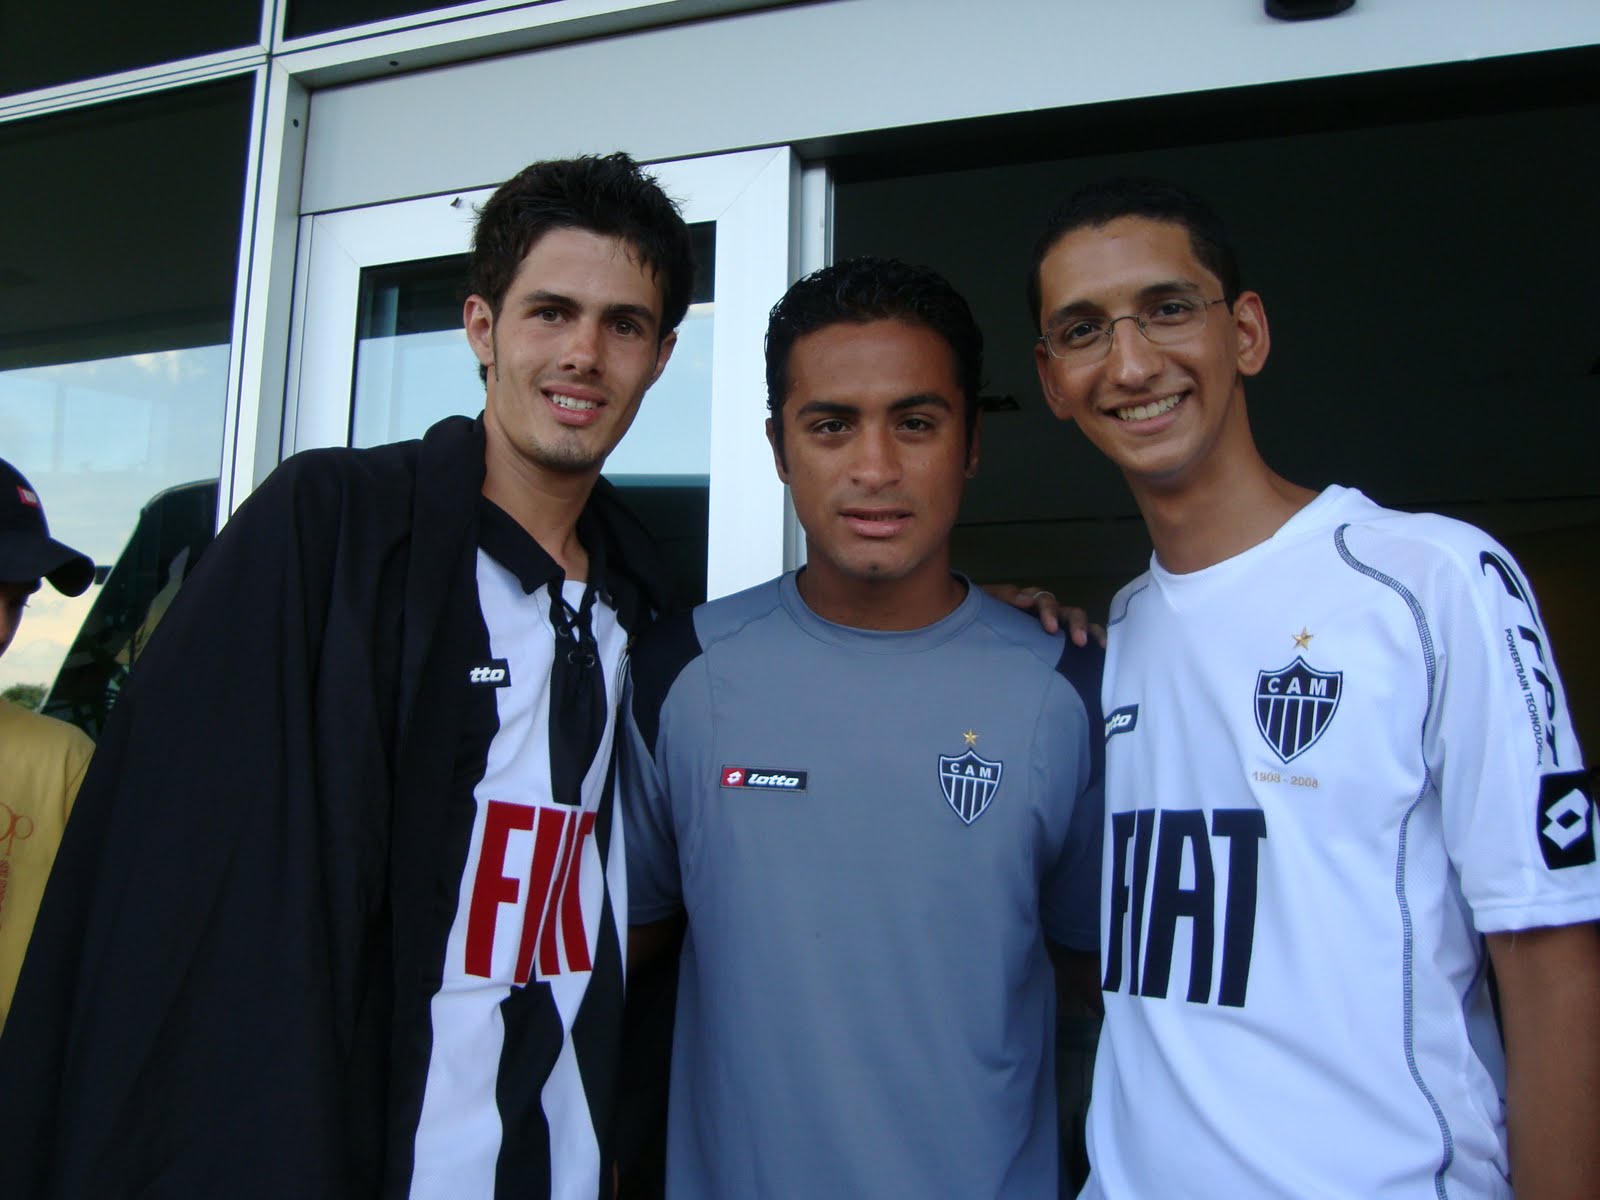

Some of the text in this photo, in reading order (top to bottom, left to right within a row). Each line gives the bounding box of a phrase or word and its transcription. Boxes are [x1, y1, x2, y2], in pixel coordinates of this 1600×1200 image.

[1267, 677, 1327, 697] CAM
[1505, 628, 1545, 766] POWERTRAIN TECHNOLOG
[748, 772, 800, 787] lotto
[950, 762, 992, 779] CAM
[1253, 771, 1281, 783] 1908
[1290, 775, 1319, 788] 2008
[1101, 808, 1268, 1008] FIAT
